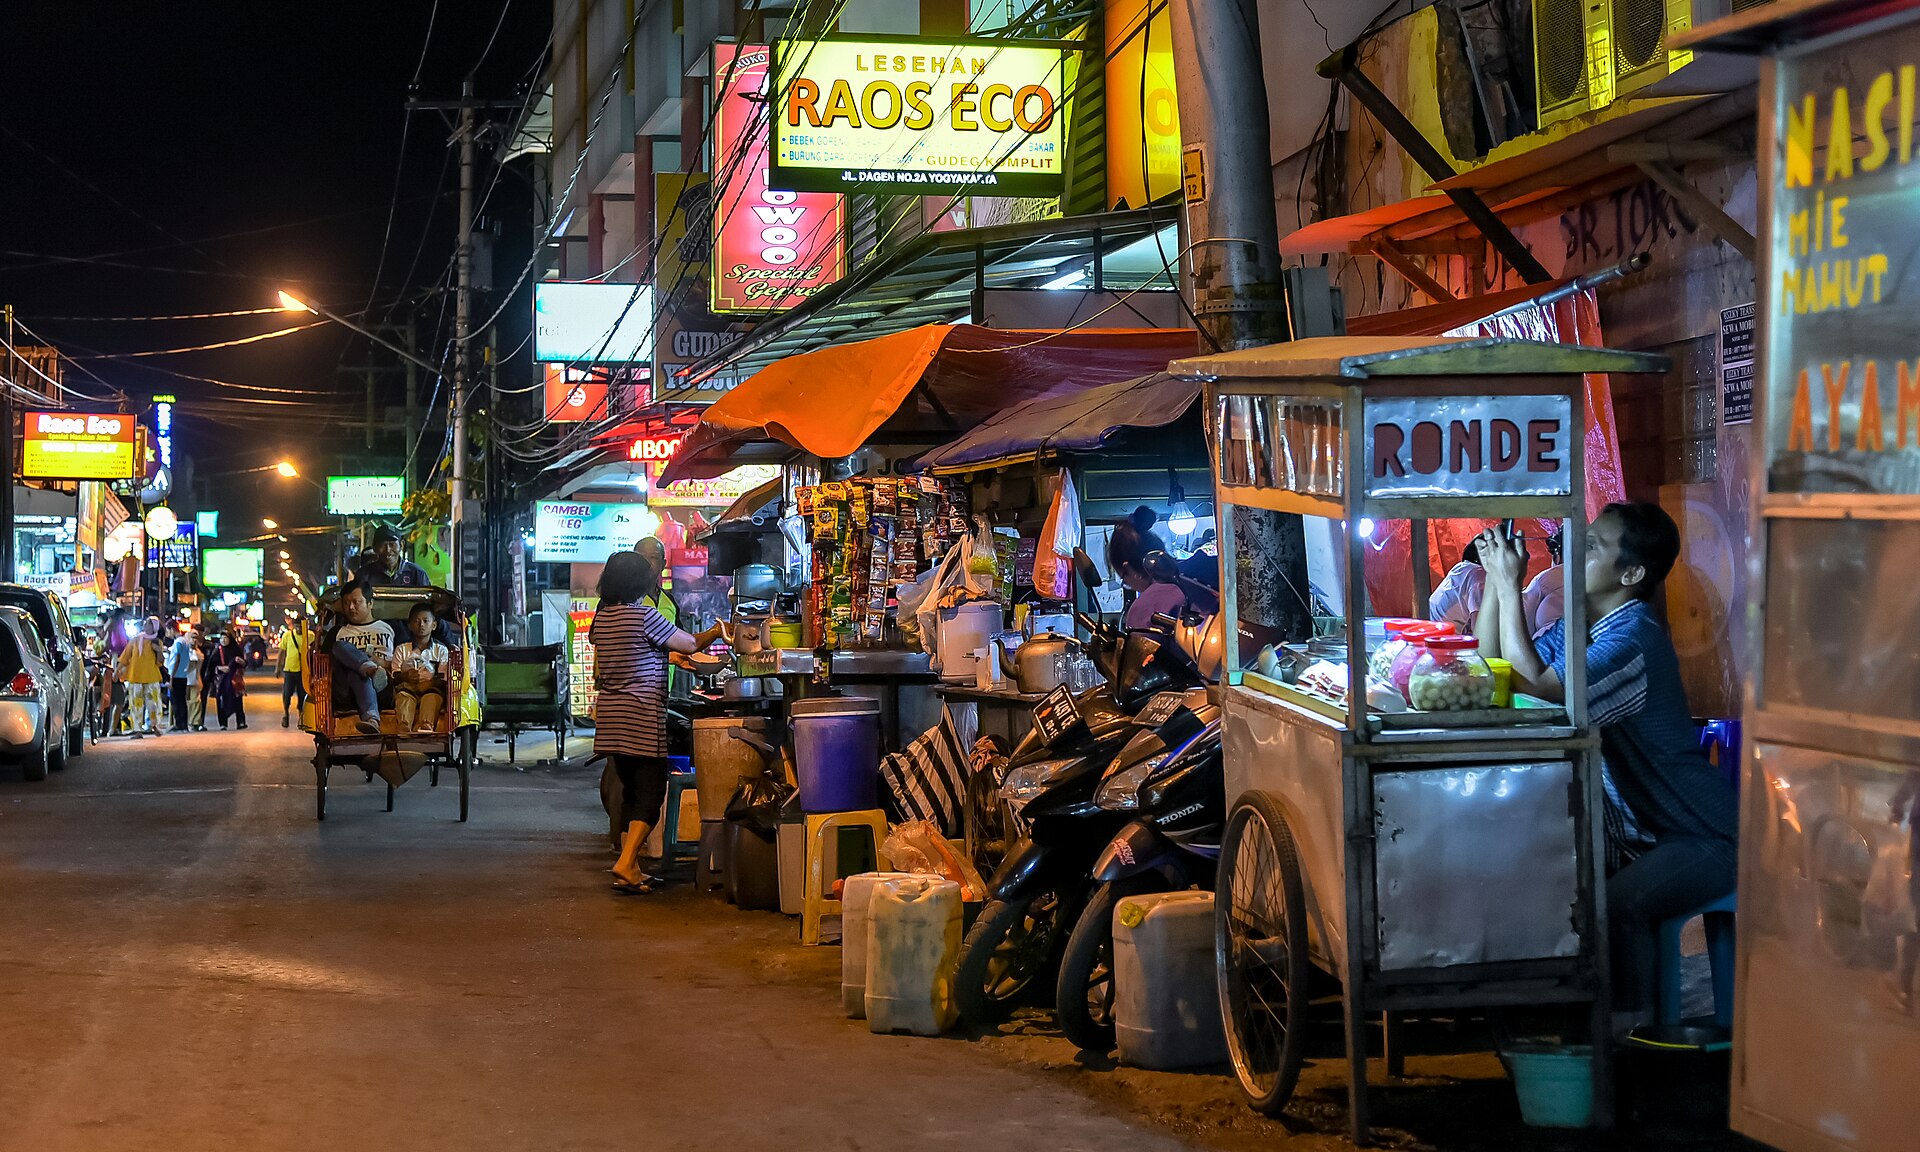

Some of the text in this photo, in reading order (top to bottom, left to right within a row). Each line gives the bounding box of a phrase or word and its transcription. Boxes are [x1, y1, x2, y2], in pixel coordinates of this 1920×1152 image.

[856, 54, 986, 75] LESEHAN
[787, 77, 934, 131] RAOS
[950, 82, 1055, 133] ECO
[1784, 64, 1916, 189] NASI
[789, 135, 815, 145] BEBEK
[1028, 142, 1055, 152] BAKAR
[789, 150, 821, 161] BURUNG
[926, 155, 1053, 169] GUDEG KOMPLIT
[841, 170, 858, 181] JL.
[859, 171, 895, 182] DAGEN
[896, 172, 928, 183] NO.2A
[1781, 253, 1888, 316] MAWUT
[1723, 323, 1739, 335] SEWA
[1724, 382, 1740, 394] SEWA
[1787, 357, 1920, 453] AYAM
[38, 414, 122, 435] Raos Eco
[1373, 418, 1562, 479] RONDE
[543, 505, 591, 516] SAMBEL
[23, 575, 46, 585] Raos
[1159, 802, 1205, 826] HONDA
